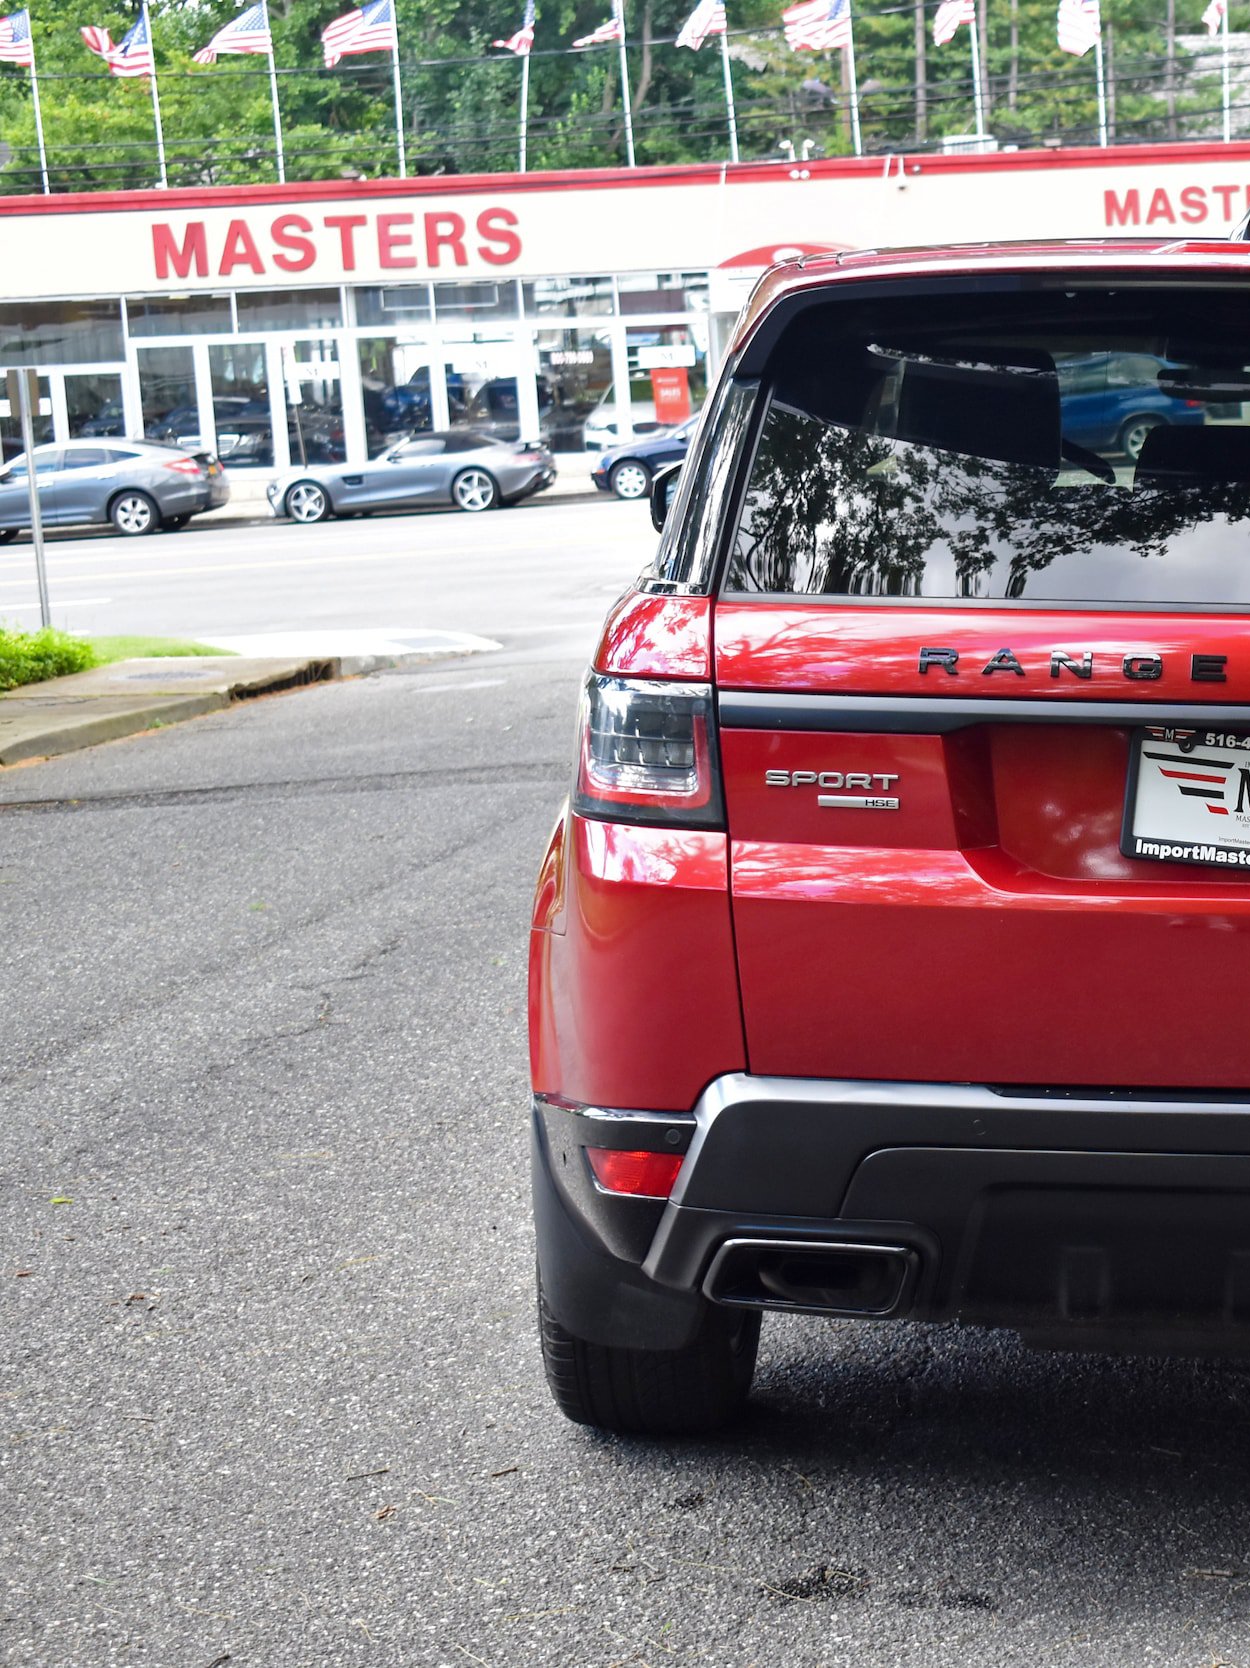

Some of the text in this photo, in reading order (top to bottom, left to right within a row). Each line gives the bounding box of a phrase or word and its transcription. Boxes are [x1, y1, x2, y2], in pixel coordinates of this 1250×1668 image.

[152, 207, 522, 279] MASTERS
[918, 647, 1228, 682] RANGE
[1165, 728, 1175, 741] M
[765, 769, 899, 790] SPORT
[865, 799, 896, 808] HSE
